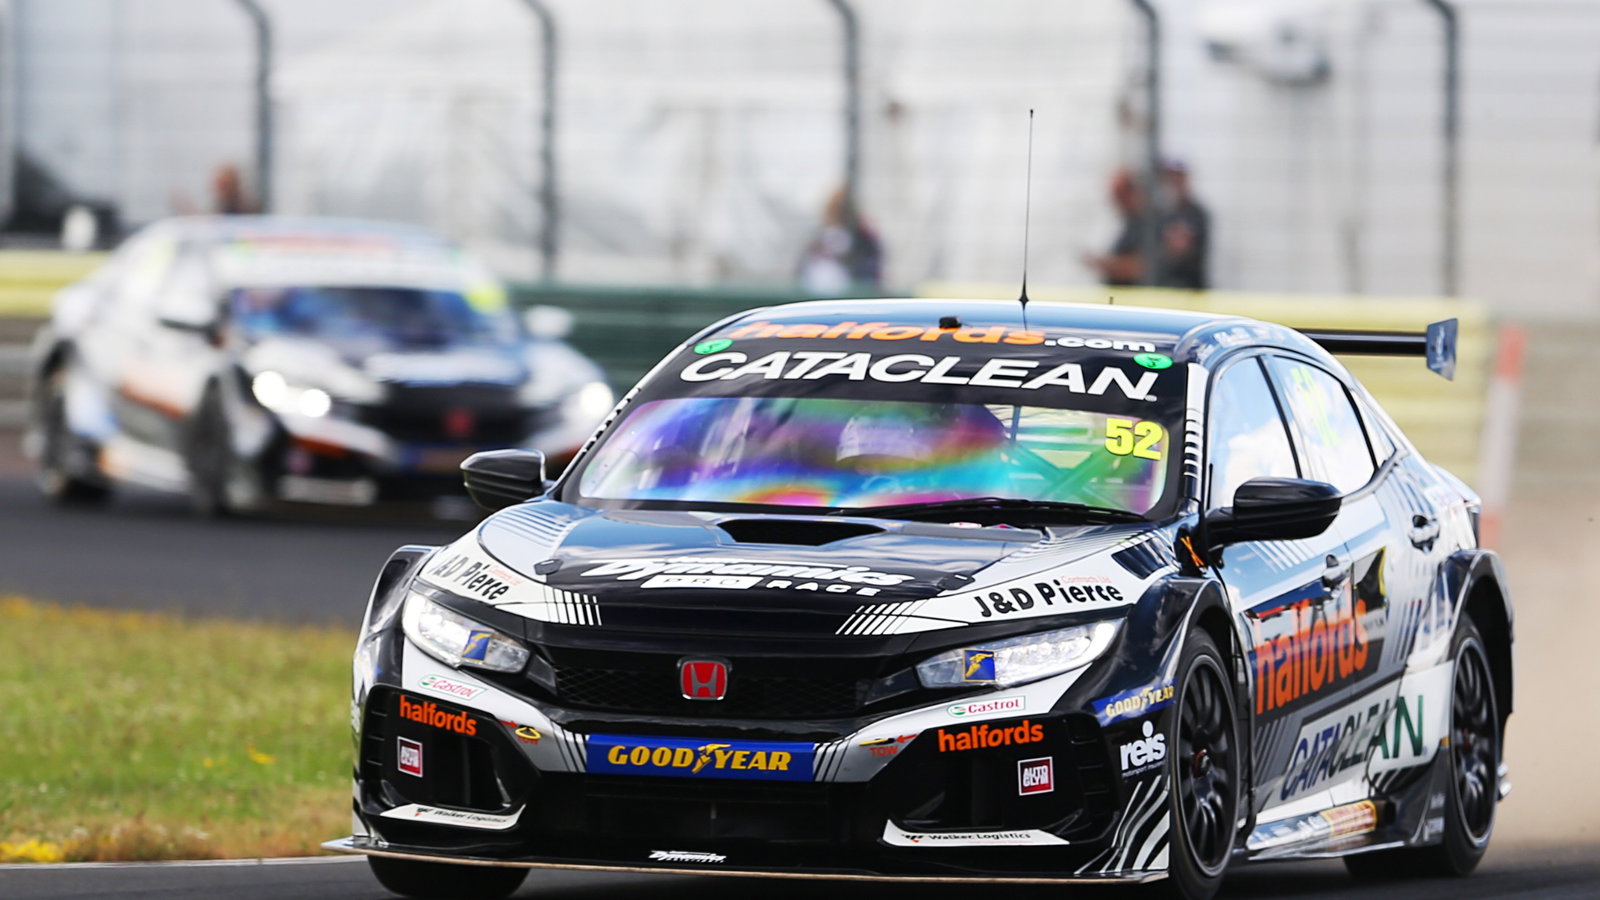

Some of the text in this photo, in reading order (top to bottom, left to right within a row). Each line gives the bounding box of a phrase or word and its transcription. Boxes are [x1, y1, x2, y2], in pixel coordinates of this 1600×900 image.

[680, 351, 1158, 400] CATACLEAN
[1105, 418, 1164, 460] 52
[453, 562, 510, 600] Pierce
[581, 558, 915, 586] Dynamics
[765, 579, 881, 597] RACE
[973, 578, 1124, 618] J&D Pierce
[432, 679, 479, 698] Castrol
[400, 695, 477, 736] halfords
[968, 697, 1021, 714] Castrol
[938, 720, 1044, 752] halfords
[1120, 720, 1166, 770] reis
[870, 747, 898, 757] TOW
[1024, 765, 1048, 777] AUTO
[976, 833, 1031, 841] Logistics
